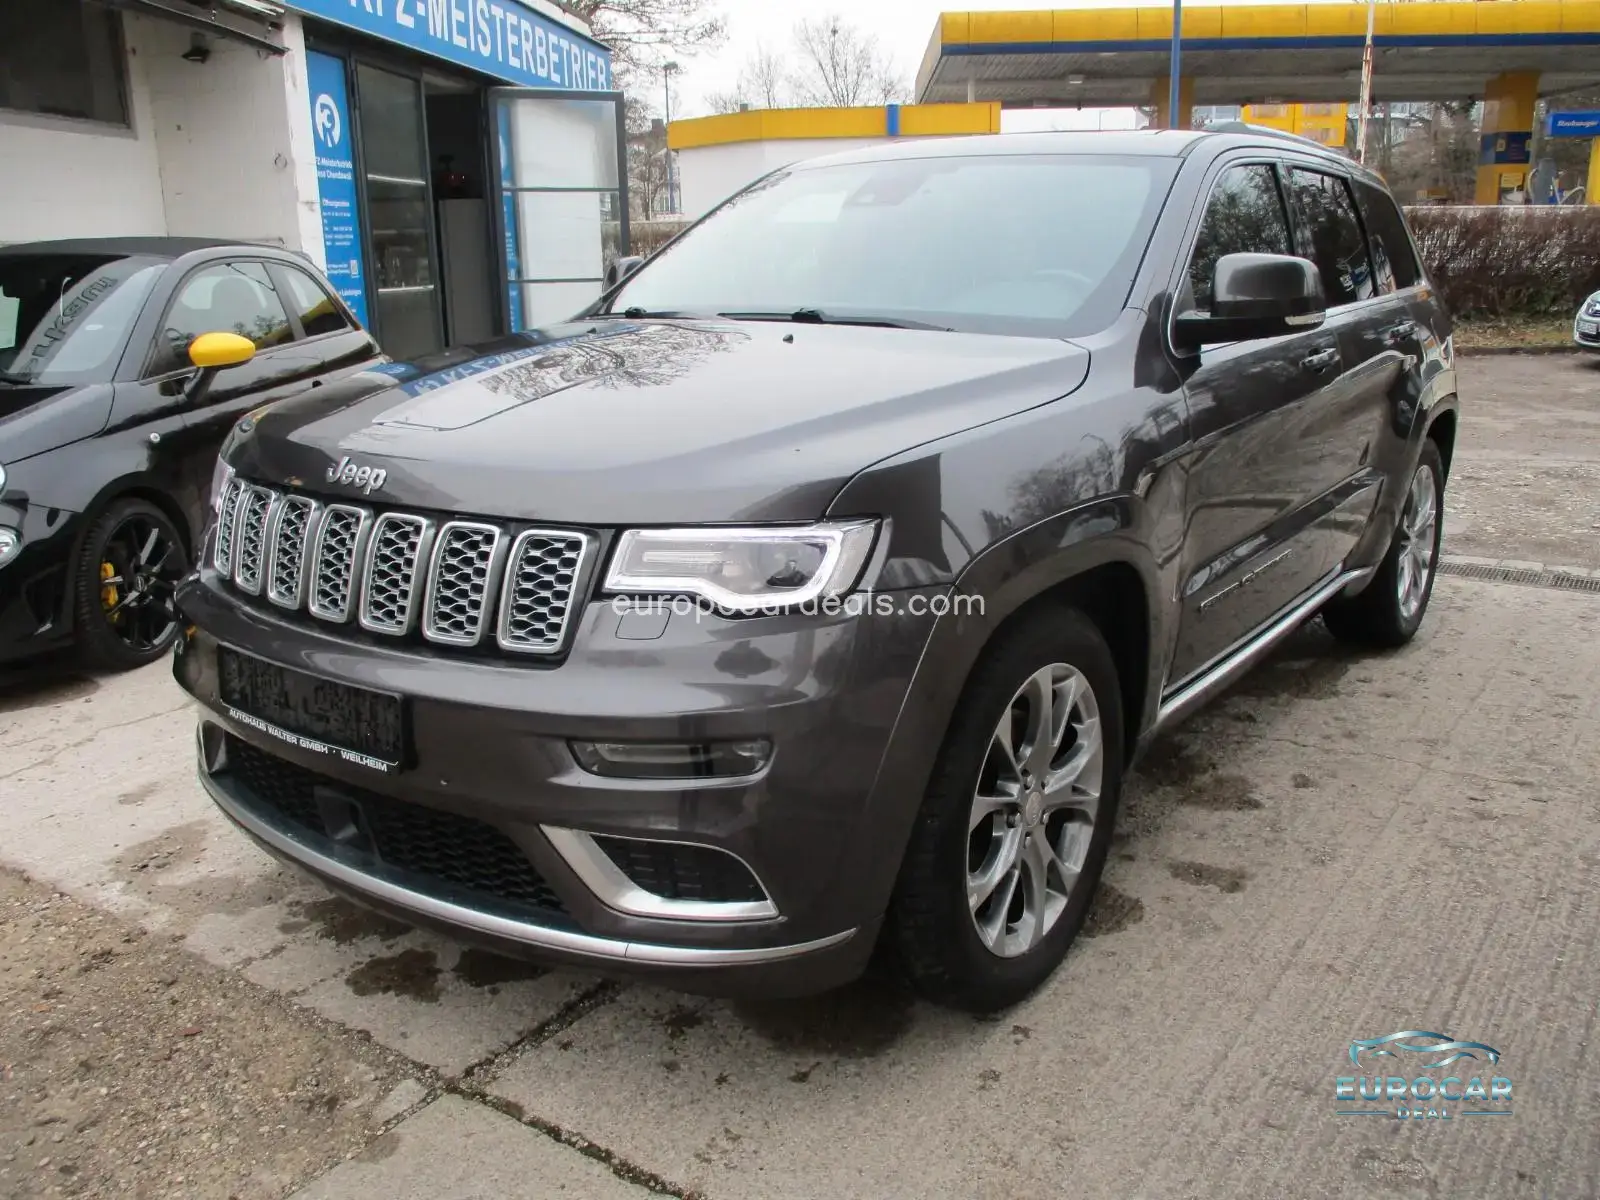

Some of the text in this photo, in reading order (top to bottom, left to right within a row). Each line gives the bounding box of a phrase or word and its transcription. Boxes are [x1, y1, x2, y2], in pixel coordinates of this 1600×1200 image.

[326, 456, 387, 495] Jeep
[229, 708, 267, 732] AUTOHAUS
[267, 725, 298, 745] WALTER
[340, 750, 388, 772] WEILHEIM
